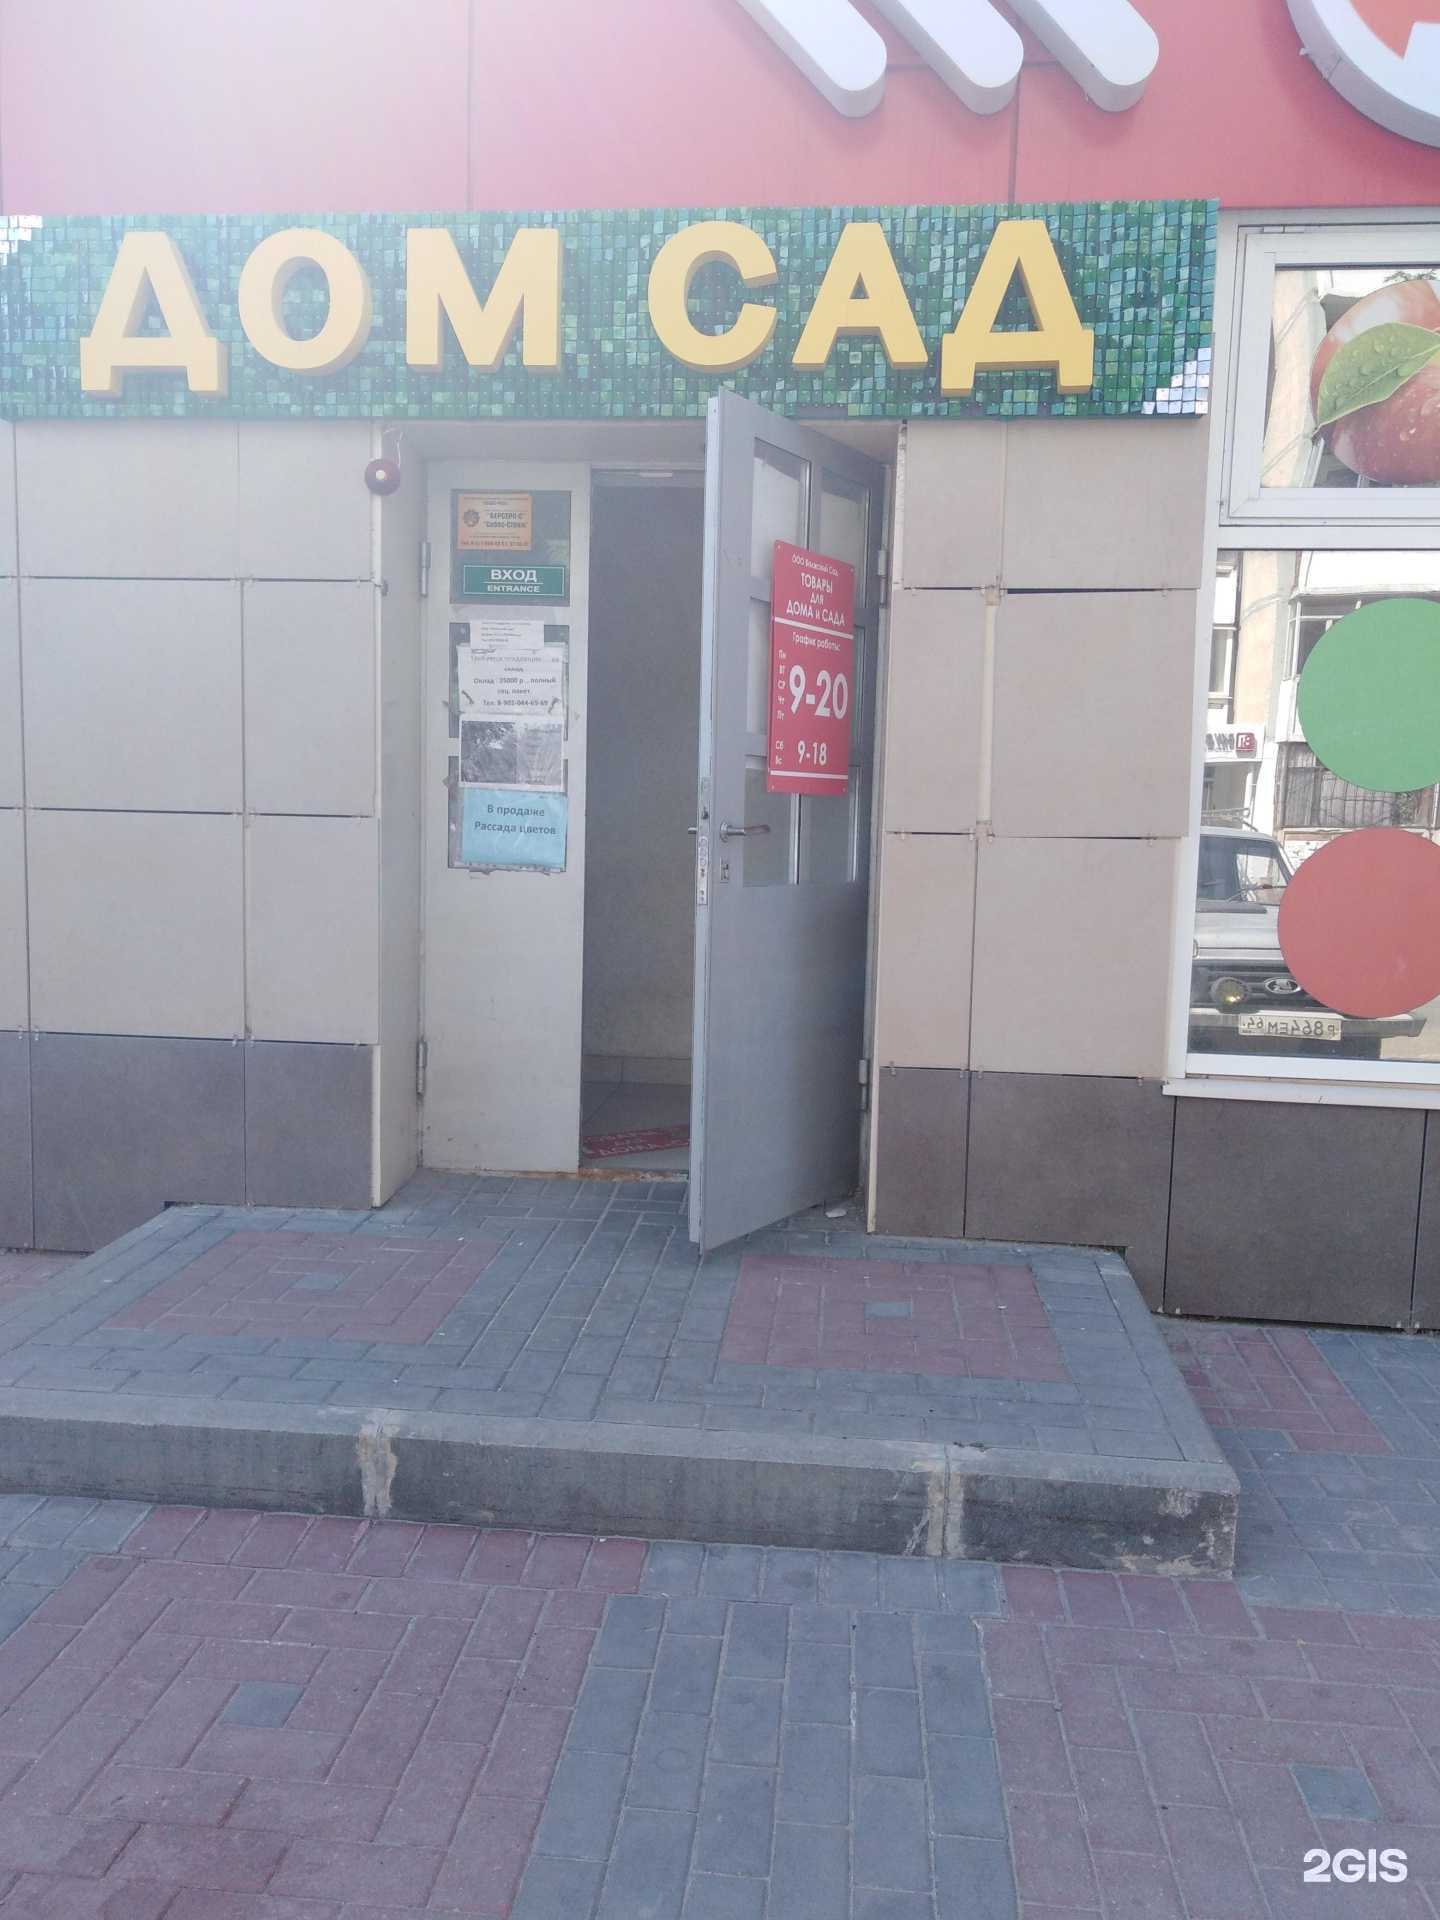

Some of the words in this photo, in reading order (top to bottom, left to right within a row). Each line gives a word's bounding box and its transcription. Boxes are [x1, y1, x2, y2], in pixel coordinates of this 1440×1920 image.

[80, 227, 562, 399] ДОМ
[647, 220, 1095, 396] САД
[792, 554, 805, 565] ООО
[491, 569, 537, 582] ВХОД
[800, 572, 833, 594] ТОВАРЫ
[487, 584, 540, 593] ENTRANCE
[786, 600, 814, 618] ДОМА
[821, 609, 845, 626] САДА
[792, 631, 816, 647] График
[789, 664, 848, 719] 9-20
[798, 740, 827, 766] 9-18
[487, 804, 493, 813] В
[497, 805, 545, 817] продаже
[474, 821, 516, 833] Рассада
[519, 824, 556, 835] цветов
